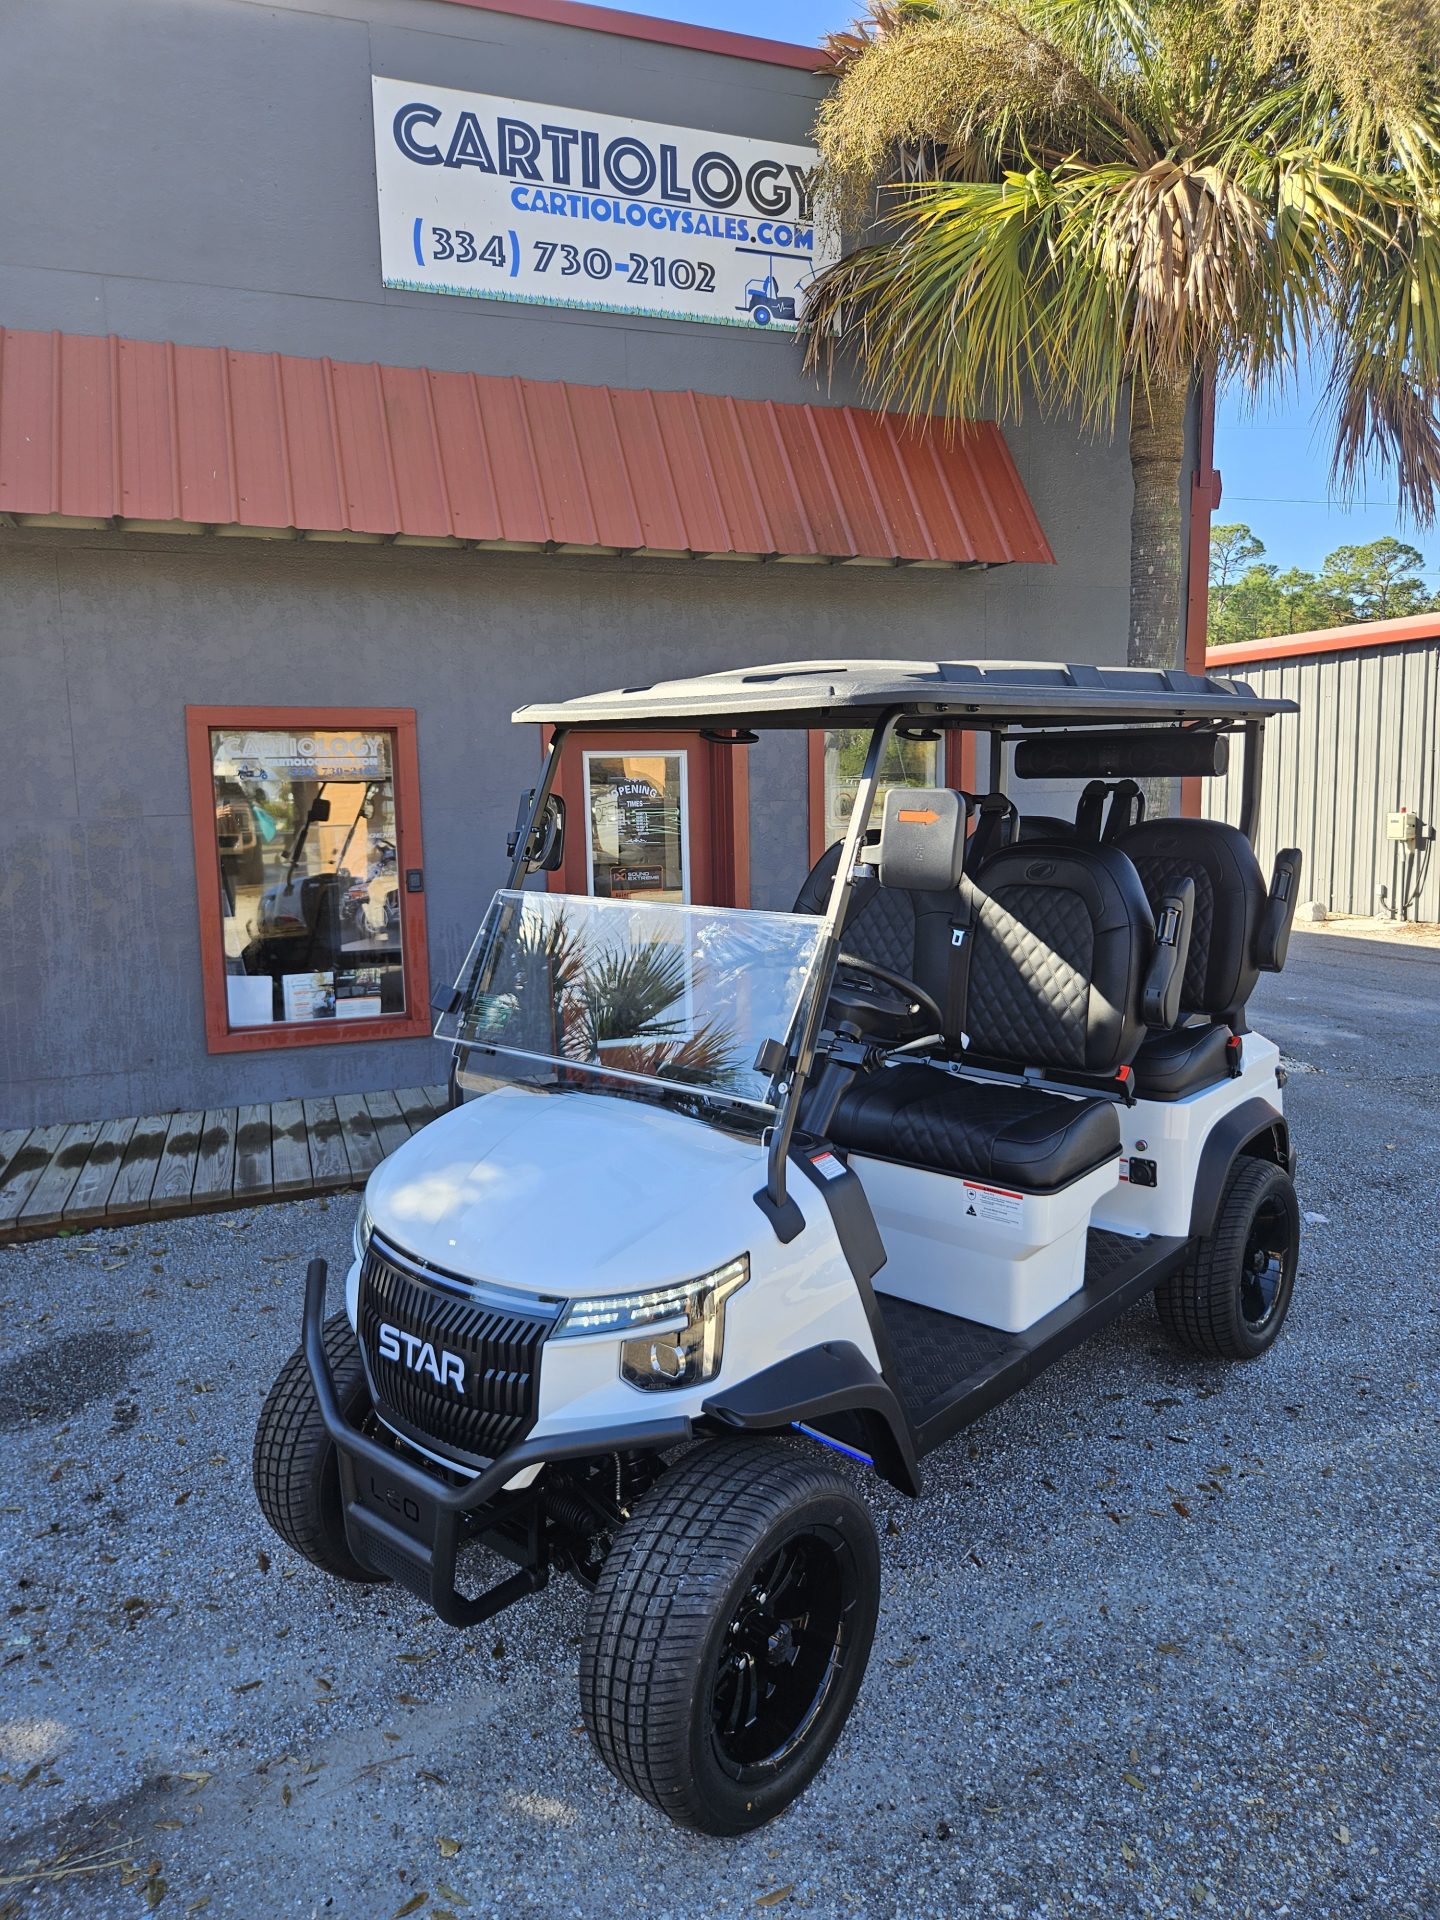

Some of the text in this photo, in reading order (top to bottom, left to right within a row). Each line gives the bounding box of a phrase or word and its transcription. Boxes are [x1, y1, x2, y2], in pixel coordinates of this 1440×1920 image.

[393, 101, 819, 222] CARTIOLOGY
[510, 185, 815, 251] CARTIOLOGYSALES.COM
[412, 217, 717, 293] (334) 730-2102
[223, 736, 380, 757] CARTIOLOGY
[610, 784, 658, 798] OPENING
[626, 800, 644, 808] TIMES
[378, 1322, 466, 1394] STAR
